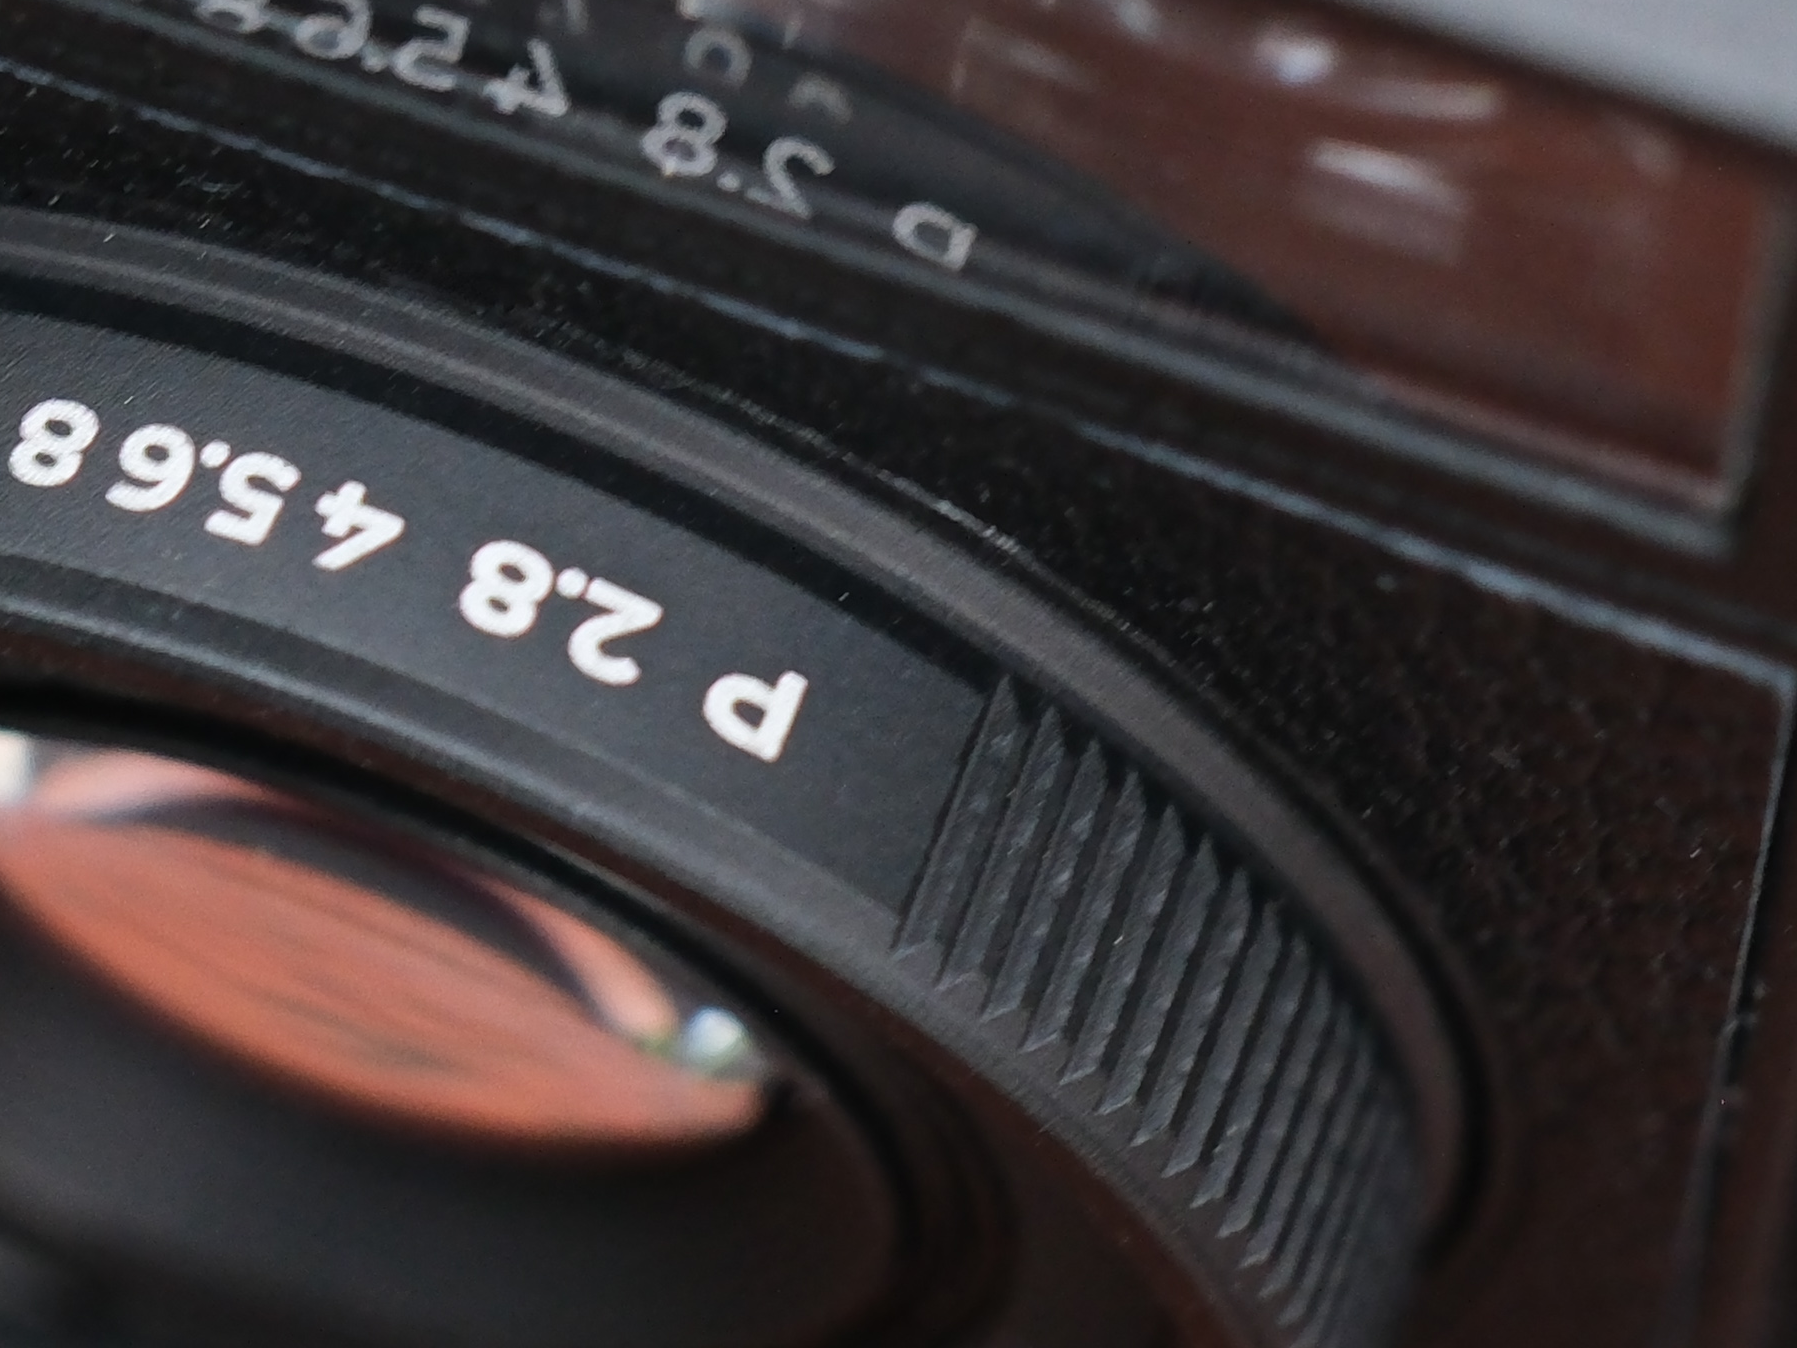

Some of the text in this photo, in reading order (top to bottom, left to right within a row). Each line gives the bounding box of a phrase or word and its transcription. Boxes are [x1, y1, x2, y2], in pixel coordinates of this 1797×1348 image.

[6, 396, 101, 489] 8
[103, 422, 303, 548] 5.6
[310, 479, 407, 573] 4
[457, 538, 664, 687] 2.8
[701, 669, 810, 764] P
